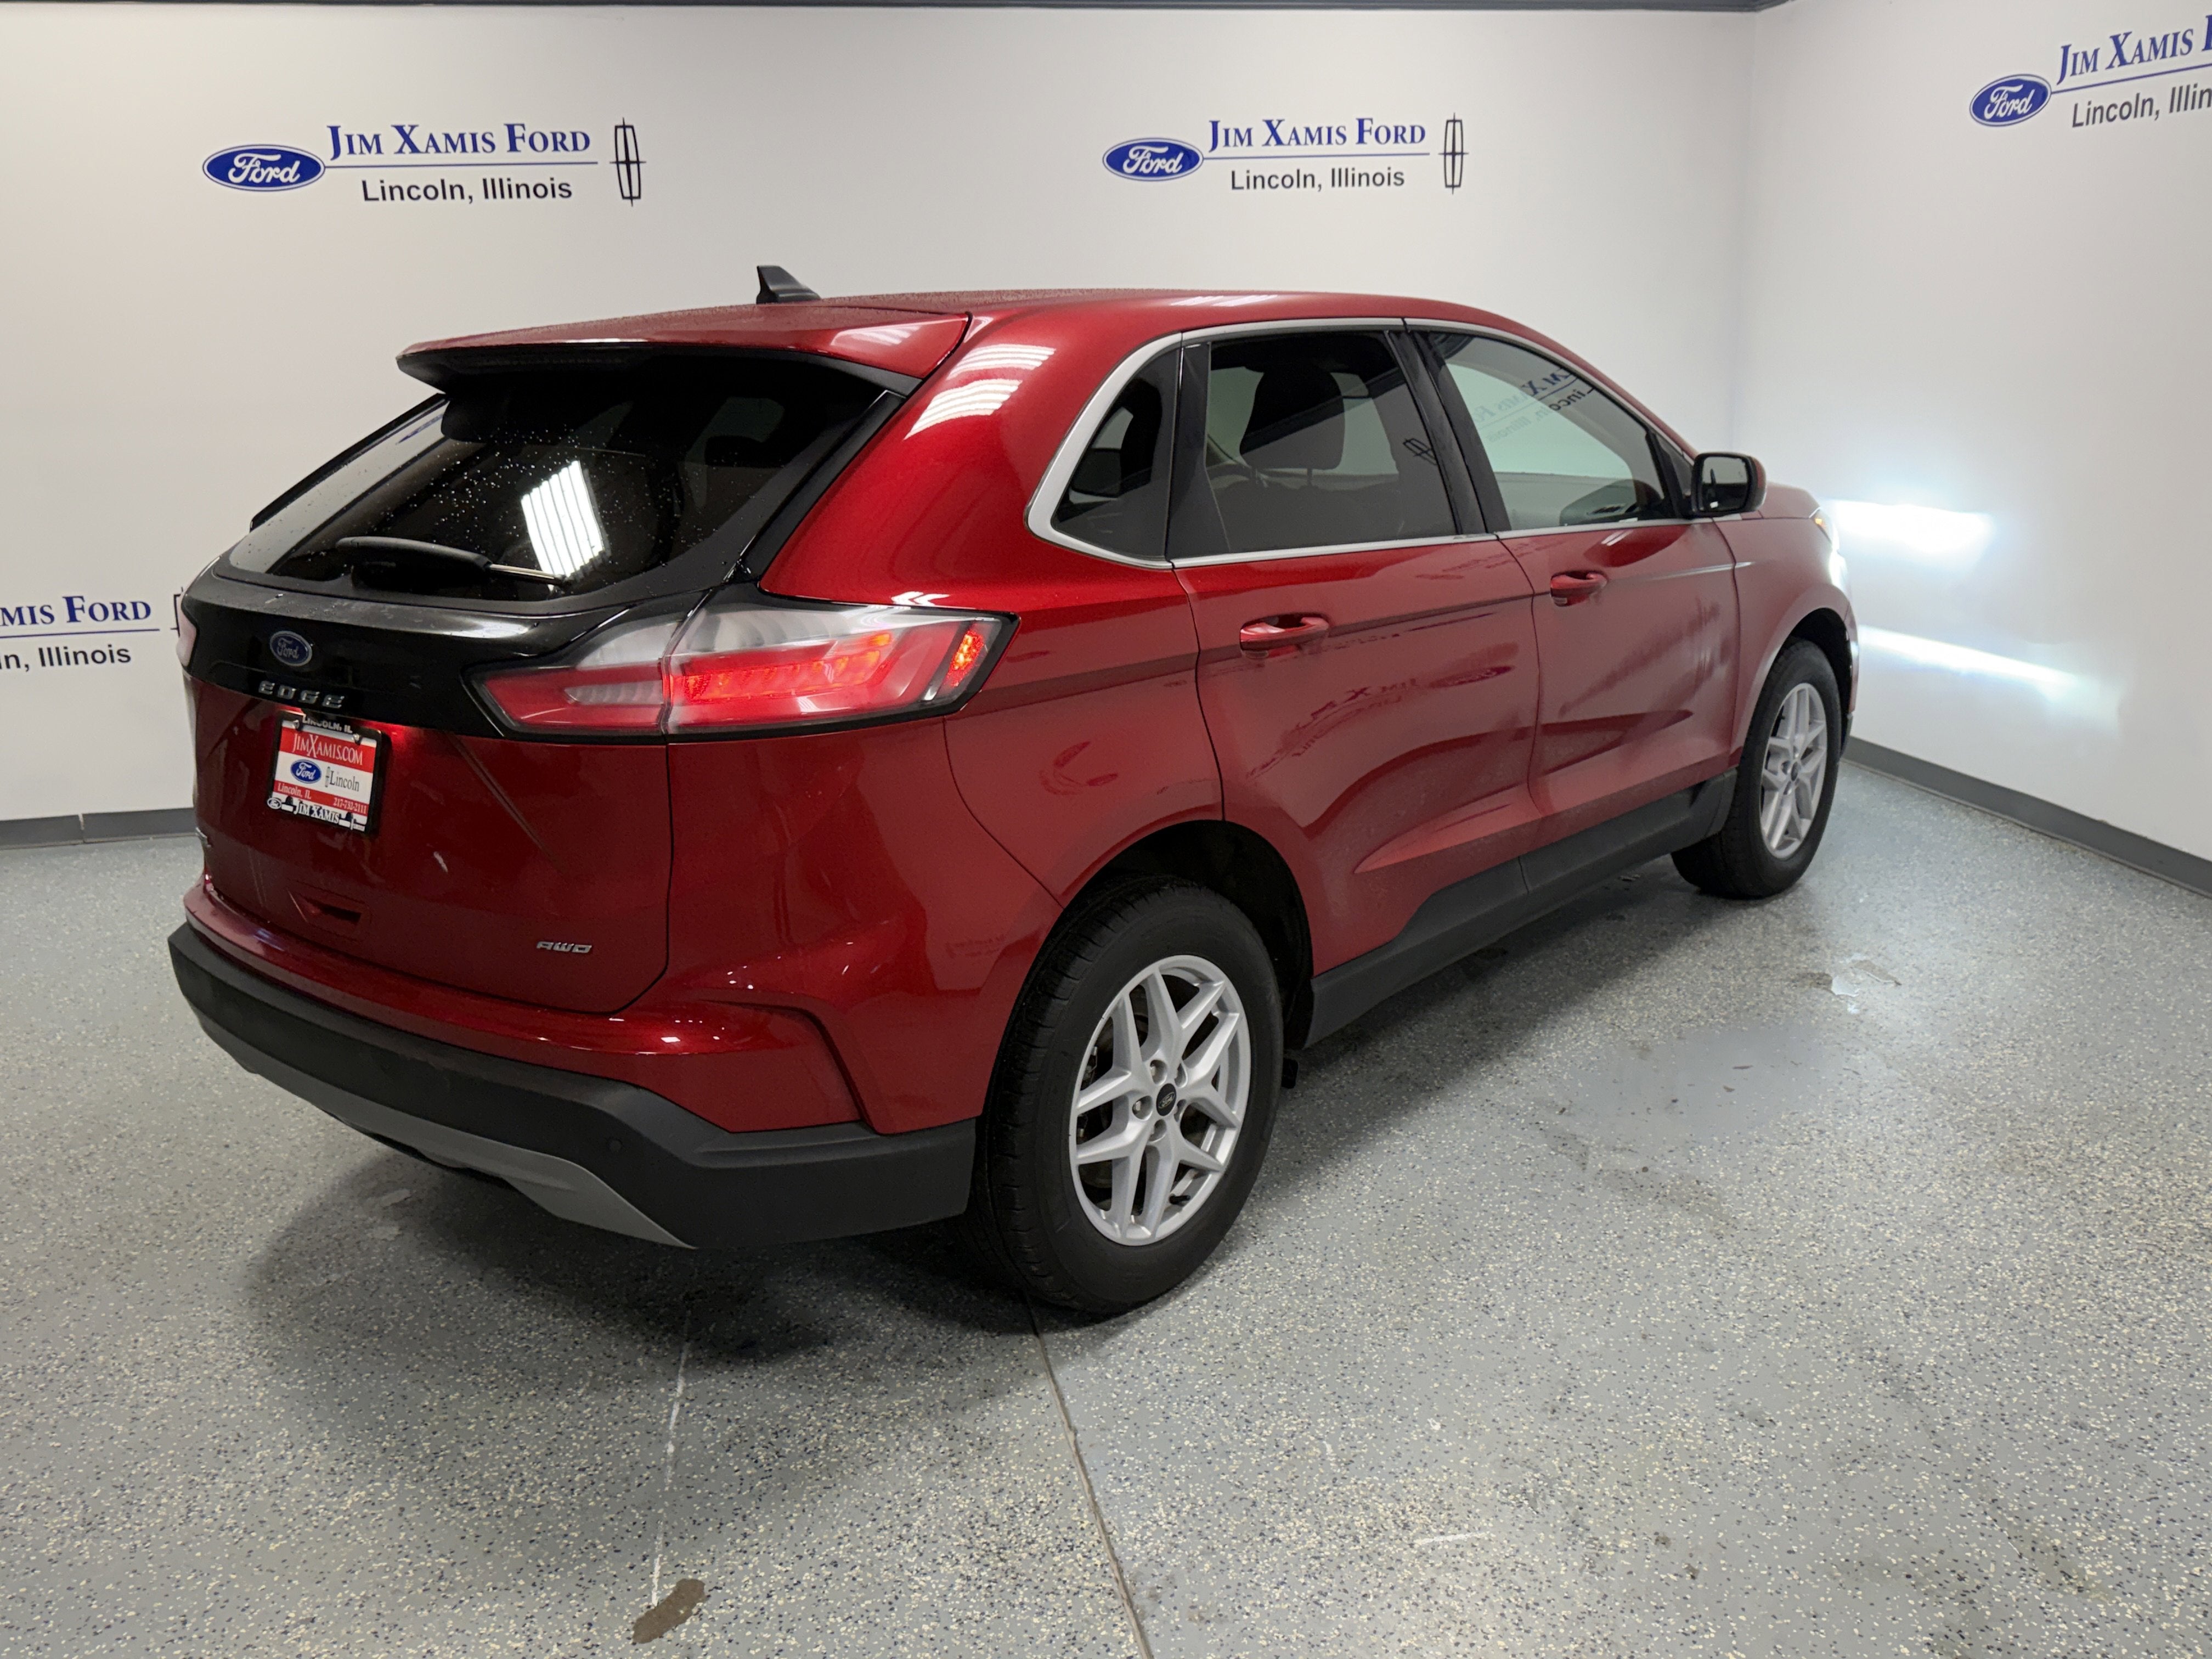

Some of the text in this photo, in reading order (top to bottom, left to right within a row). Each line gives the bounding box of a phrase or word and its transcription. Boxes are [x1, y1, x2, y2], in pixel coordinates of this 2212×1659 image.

[2057, 44, 2100, 85] JIM
[2105, 29, 2194, 69] XAMIS
[1984, 84, 2035, 120] Ford
[2072, 83, 2212, 127] Lincoln, Illin
[327, 122, 590, 161] JIM XAMIS FORD
[1209, 118, 1425, 153] JIM XAMIS FORD
[227, 153, 301, 184] Ford
[1122, 145, 1182, 173] Ford
[362, 177, 572, 204] Lincoln, Illinois
[1231, 167, 1404, 192] Lincoln, Illinois
[0, 595, 151, 627] MIS FORD
[38, 644, 131, 667] Illinois
[276, 637, 300, 659] Ford
[258, 680, 345, 709] EDGE
[295, 762, 317, 780] Ford
[330, 770, 360, 792] Lincoln
[537, 941, 592, 953] AWD
